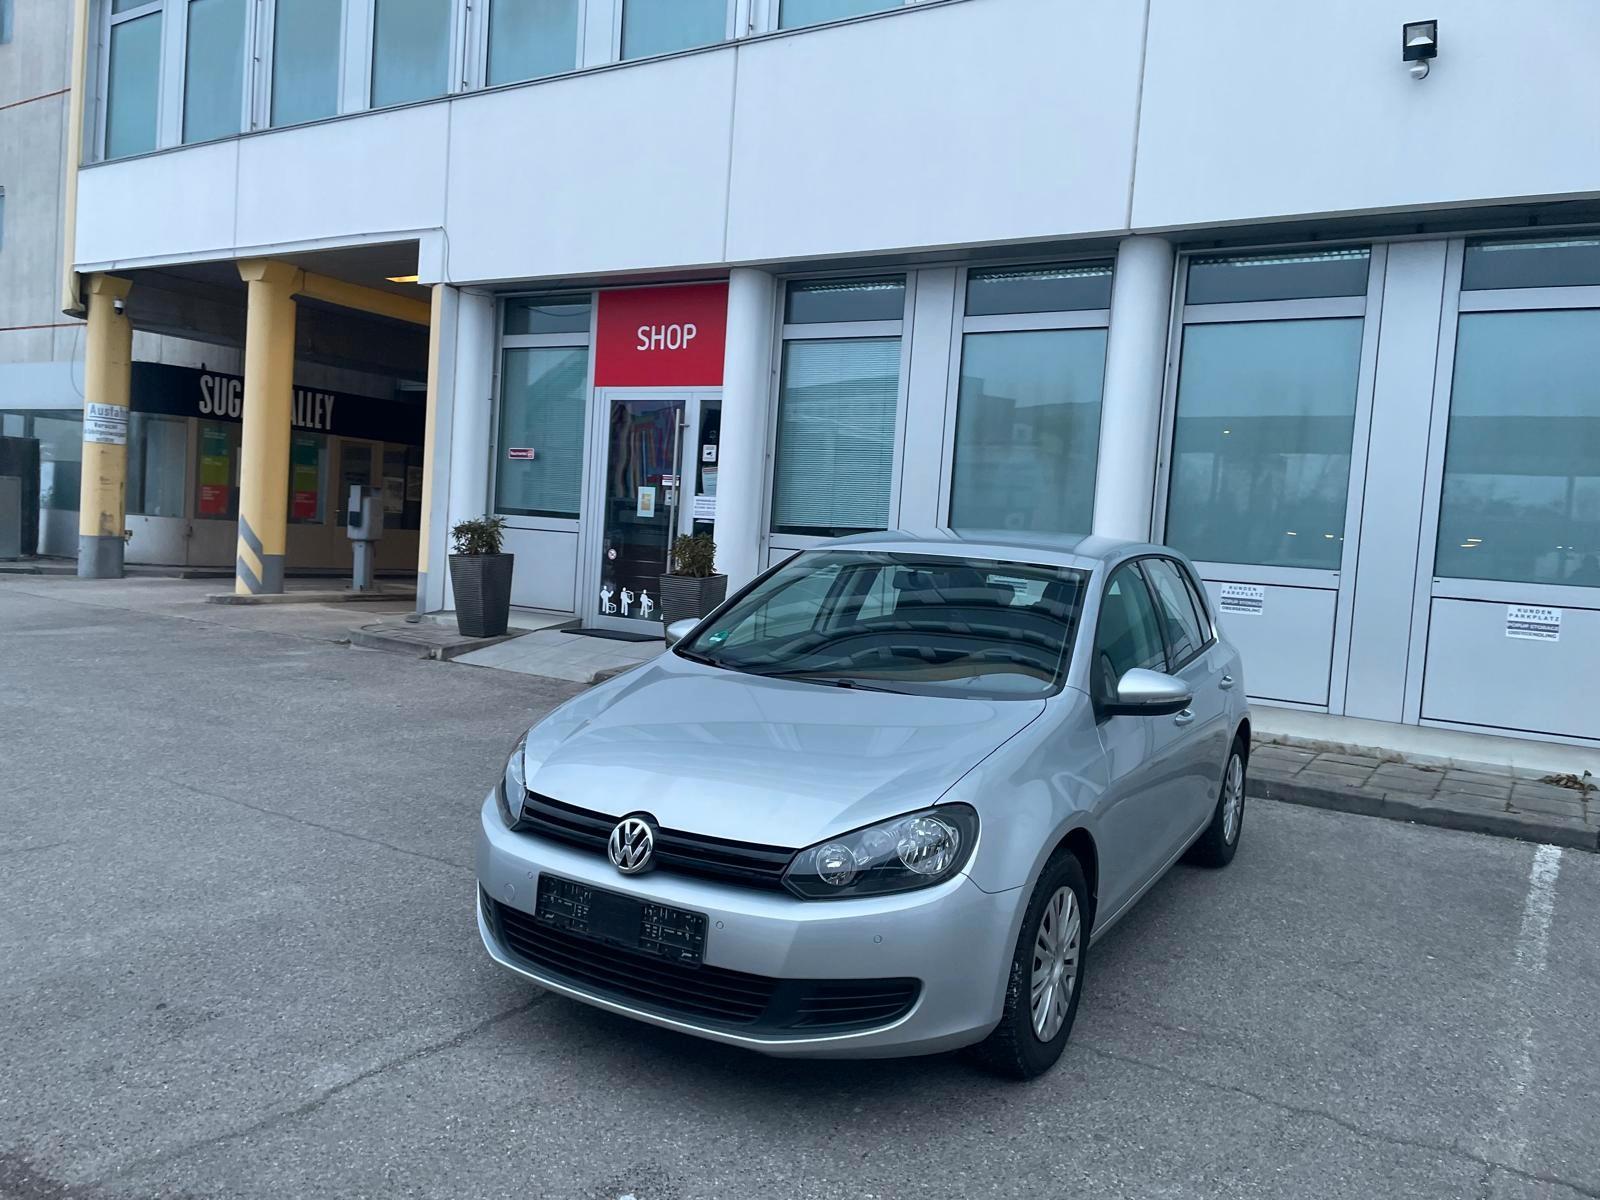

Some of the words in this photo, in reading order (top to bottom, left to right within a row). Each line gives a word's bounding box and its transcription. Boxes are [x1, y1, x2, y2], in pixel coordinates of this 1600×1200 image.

[637, 323, 697, 351] SHOP
[198, 374, 243, 418] SUG
[1508, 613, 1559, 621] PARKPLATZ
